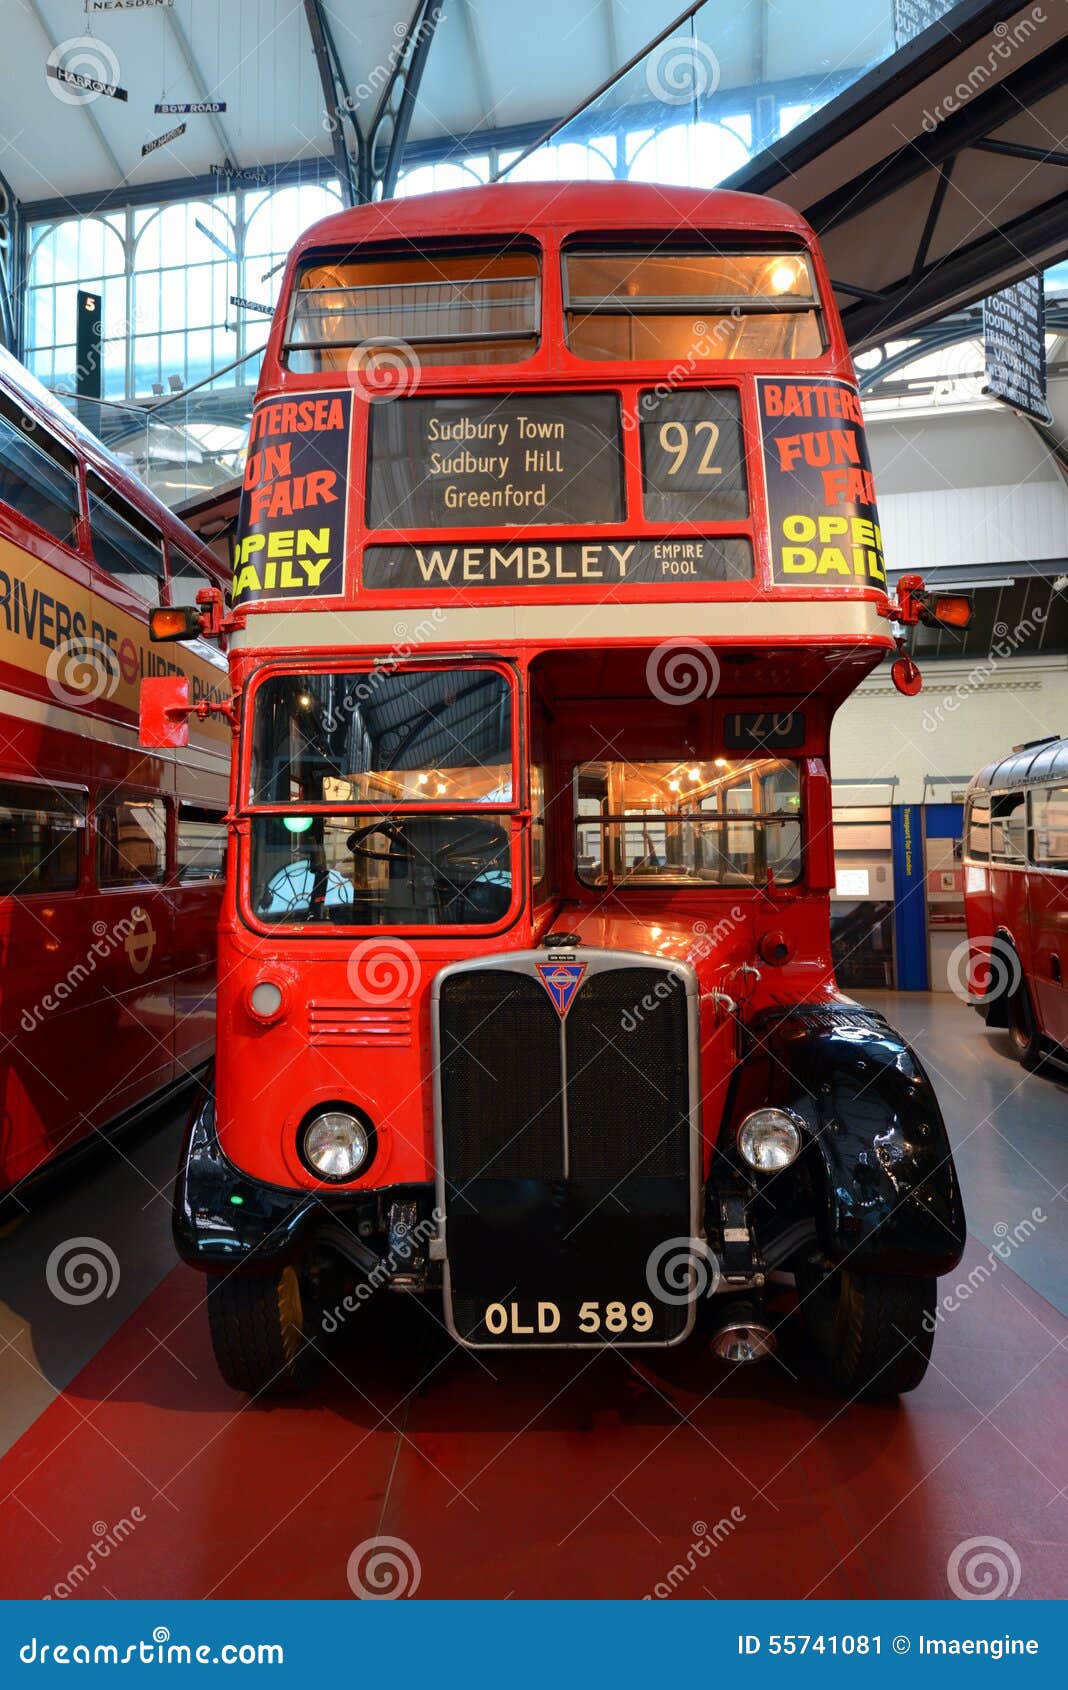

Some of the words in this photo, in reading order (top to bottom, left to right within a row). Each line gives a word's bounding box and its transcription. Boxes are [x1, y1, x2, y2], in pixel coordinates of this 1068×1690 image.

[58, 68, 116, 96] HARROW
[162, 104, 186, 113] BOW
[190, 103, 220, 112] ROAD
[85, 296, 96, 311] 5
[992, 347, 1040, 384] VAUXHALL
[428, 418, 509, 446] Sudbury
[517, 417, 564, 440] Town
[658, 422, 722, 475] 92
[430, 450, 510, 478] Sudbury
[525, 450, 564, 474] Hill
[774, 430, 860, 472] FUN
[249, 470, 340, 526] FAIR
[444, 484, 546, 508] Greenford
[821, 468, 878, 506] FAI
[234, 528, 330, 572] PEN
[416, 544, 636, 582] WEMBLEY
[654, 544, 704, 559] EMPIRE
[232, 558, 332, 601] AILY
[662, 561, 698, 575] POOL
[484, 1302, 560, 1334] OLD
[578, 1301, 654, 1334] 589
